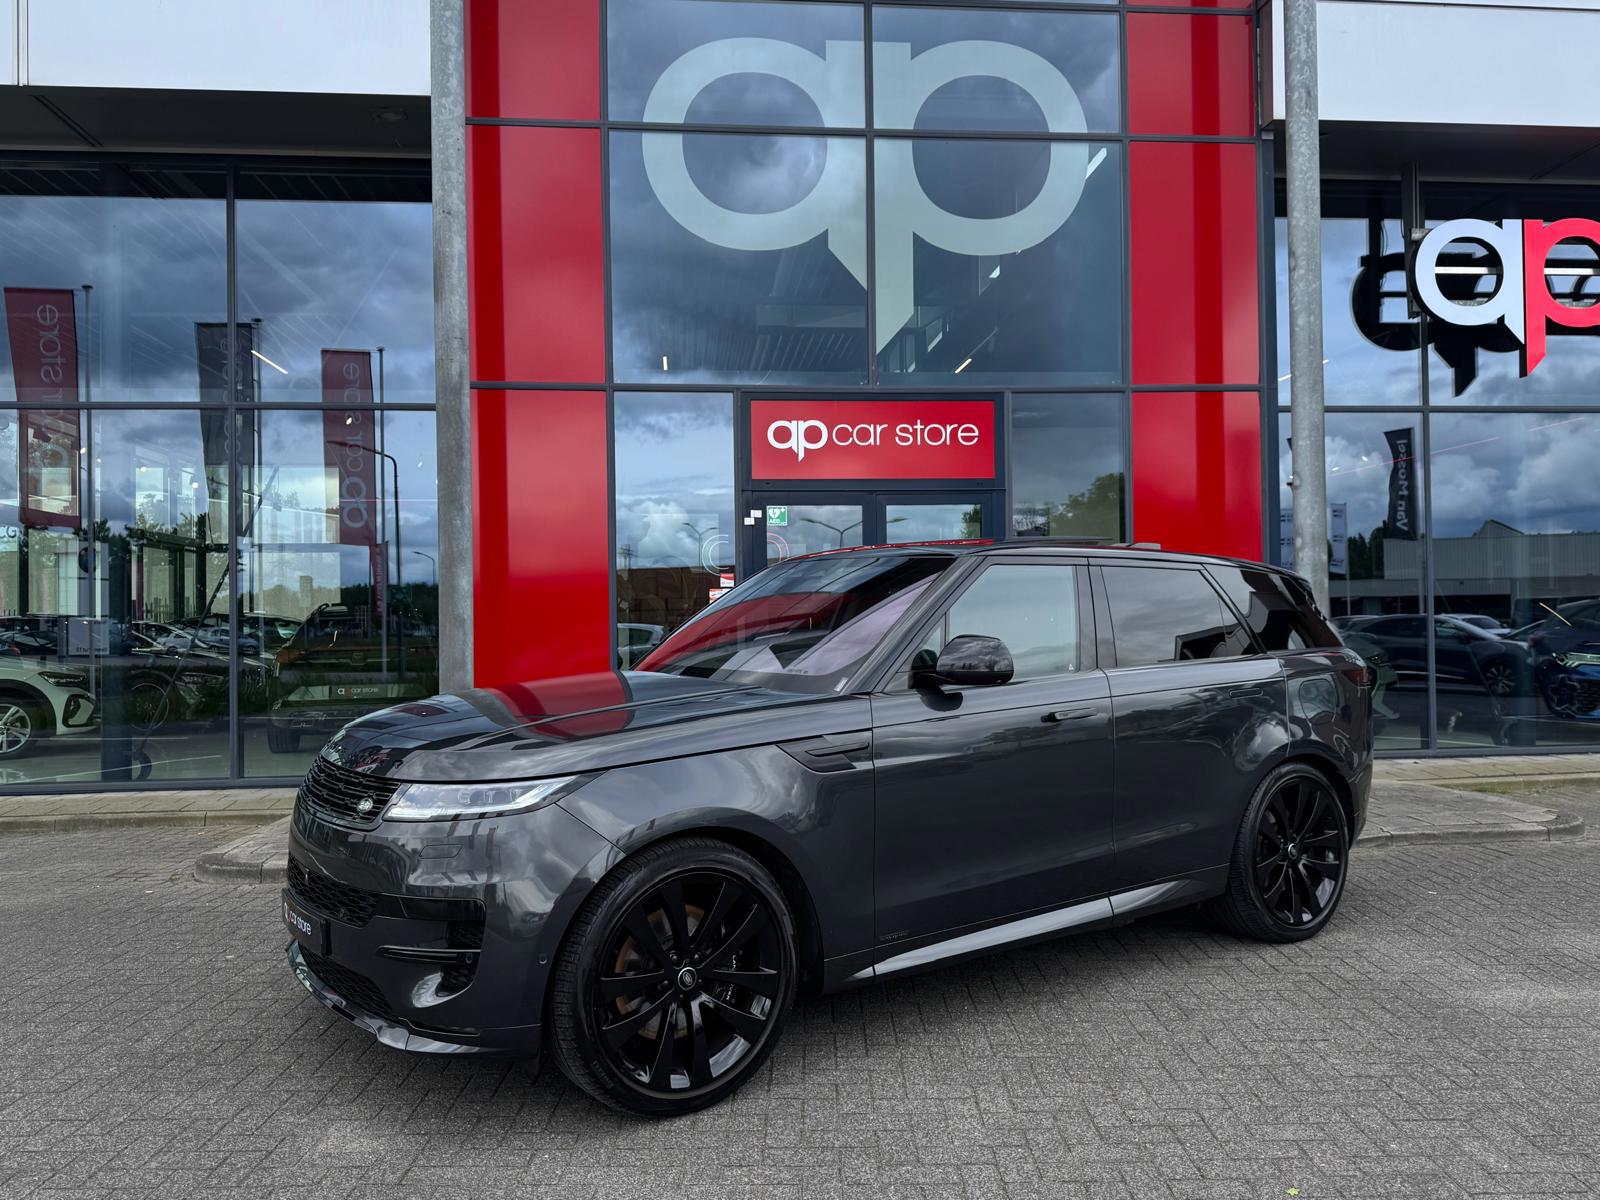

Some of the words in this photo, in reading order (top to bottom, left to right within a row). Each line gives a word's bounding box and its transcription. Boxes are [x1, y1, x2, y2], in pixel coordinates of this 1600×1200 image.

[642, 37, 1089, 355] ap
[767, 419, 829, 462] ap
[832, 423, 888, 446] car
[895, 418, 979, 446] store
[297, 917, 312, 935] store
